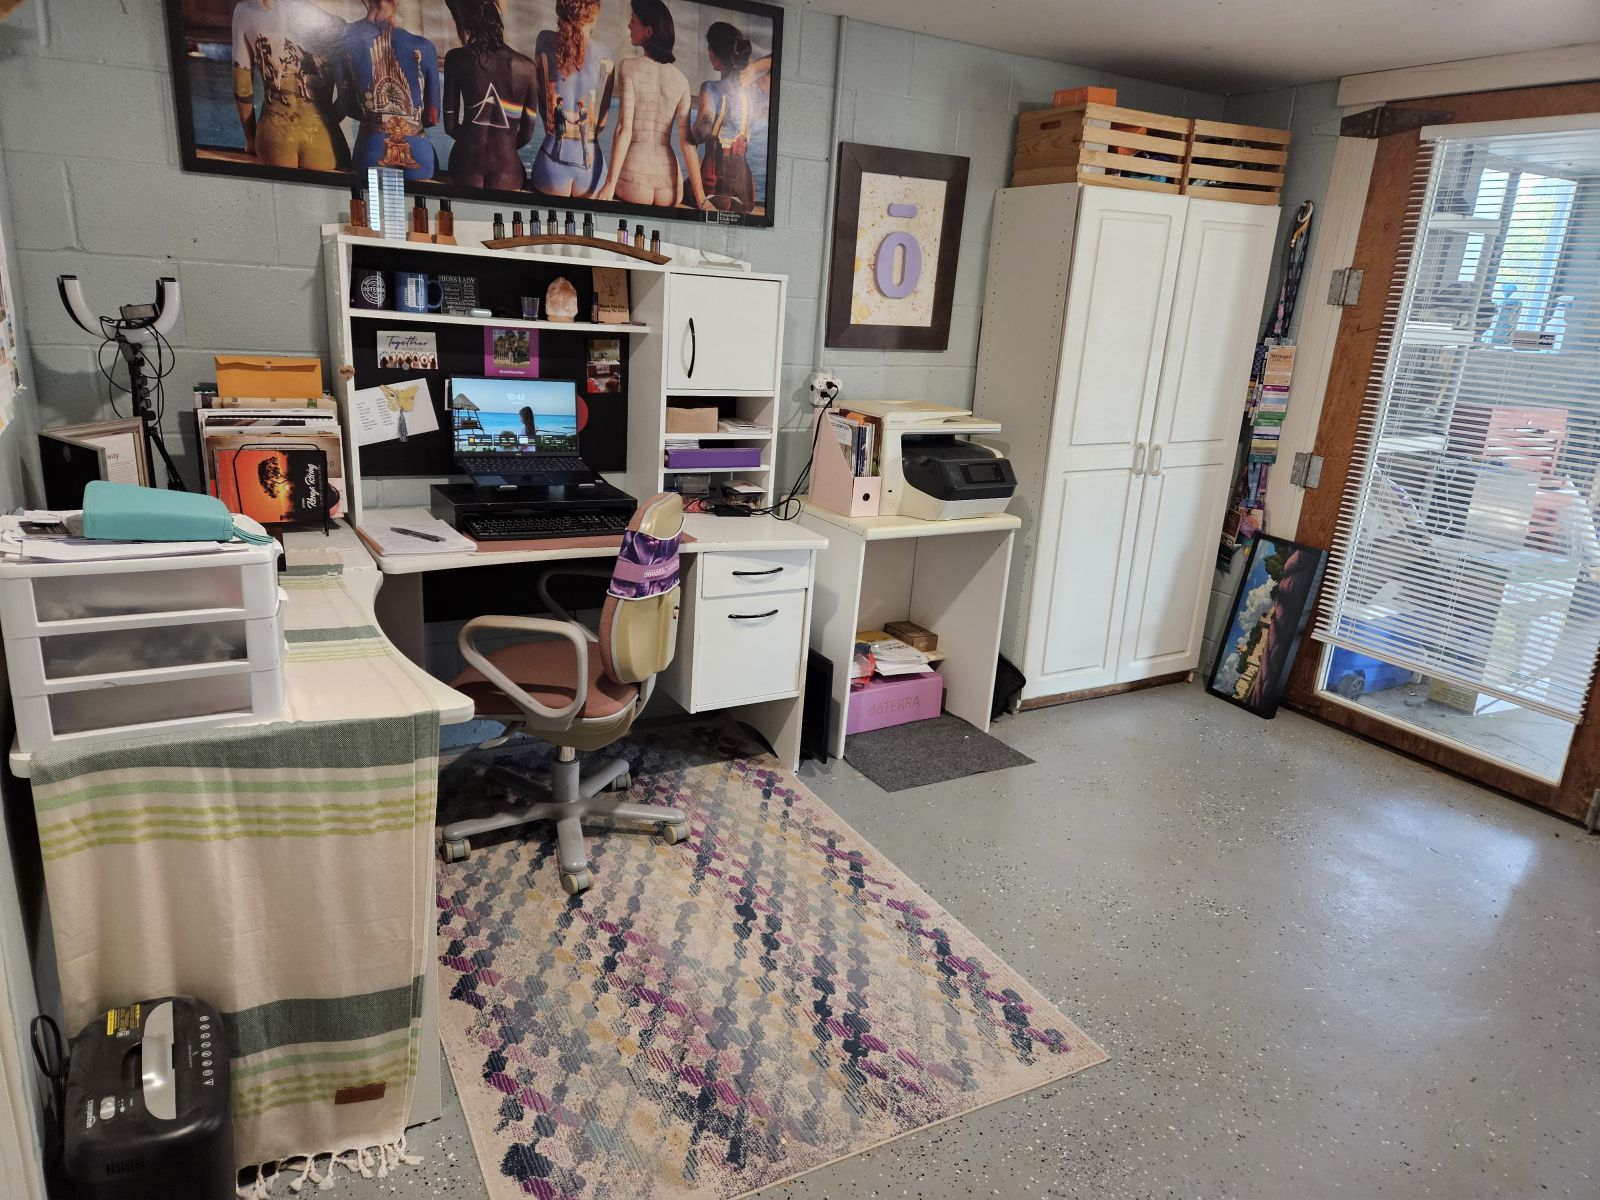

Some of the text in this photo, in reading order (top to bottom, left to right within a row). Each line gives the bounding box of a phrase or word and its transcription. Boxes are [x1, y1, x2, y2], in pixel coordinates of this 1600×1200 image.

[441, 275, 476, 284] BOSS LADY
[386, 335, 429, 350] Together
[506, 393, 525, 401] 10:42
[868, 695, 920, 717] dōTERRA
